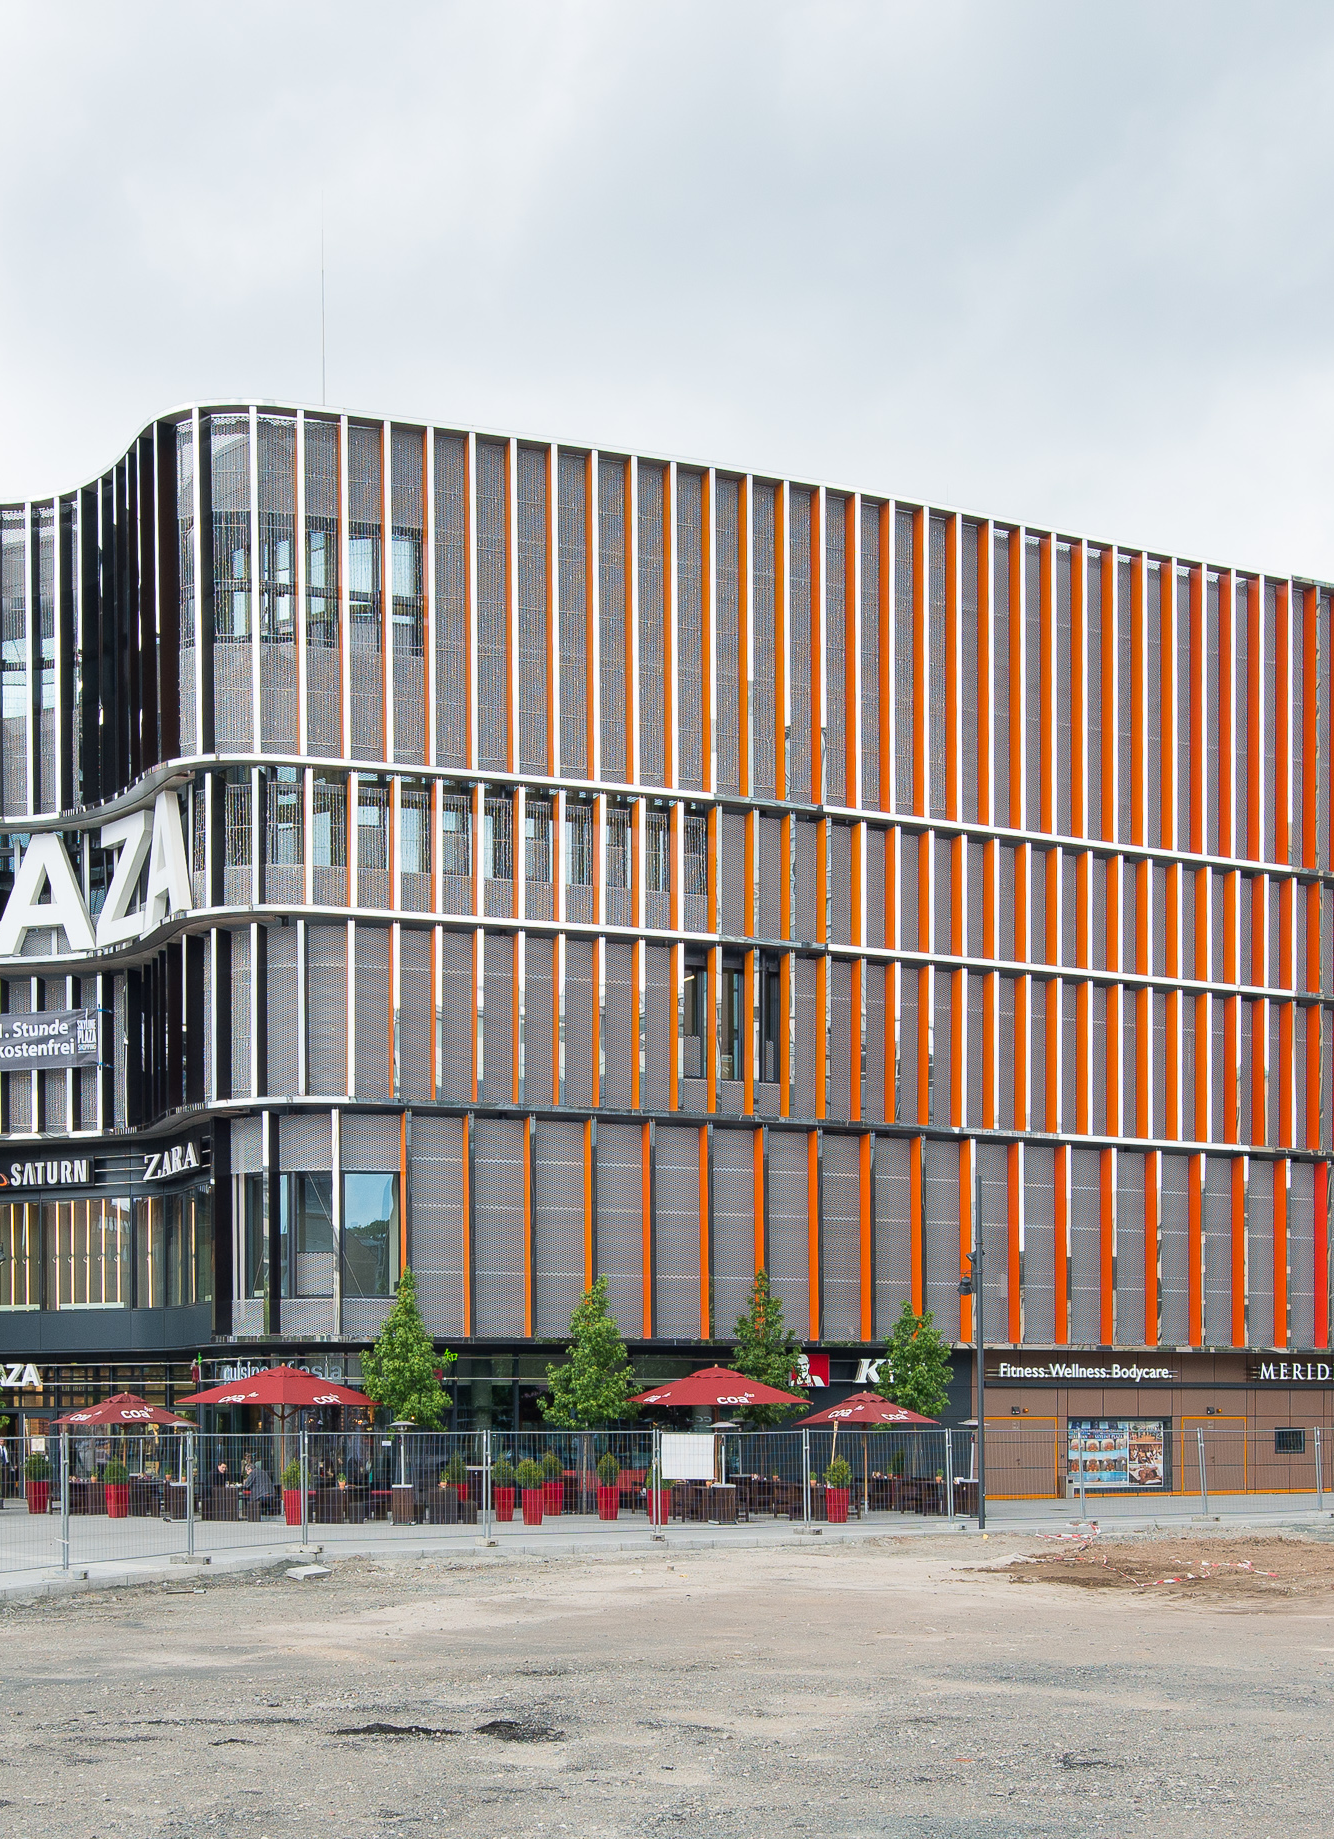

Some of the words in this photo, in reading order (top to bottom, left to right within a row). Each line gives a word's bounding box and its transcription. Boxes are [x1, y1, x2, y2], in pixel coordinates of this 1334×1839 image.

[13, 1019, 68, 1037] Stunde
[77, 1030, 96, 1043] PLAZA
[143, 1142, 201, 1181] ZARA
[10, 1159, 90, 1187] SATURN
[999, 1363, 1048, 1378] Fitness.
[1049, 1363, 1110, 1379] Wellness.
[1112, 1363, 1173, 1383] Bodycare.
